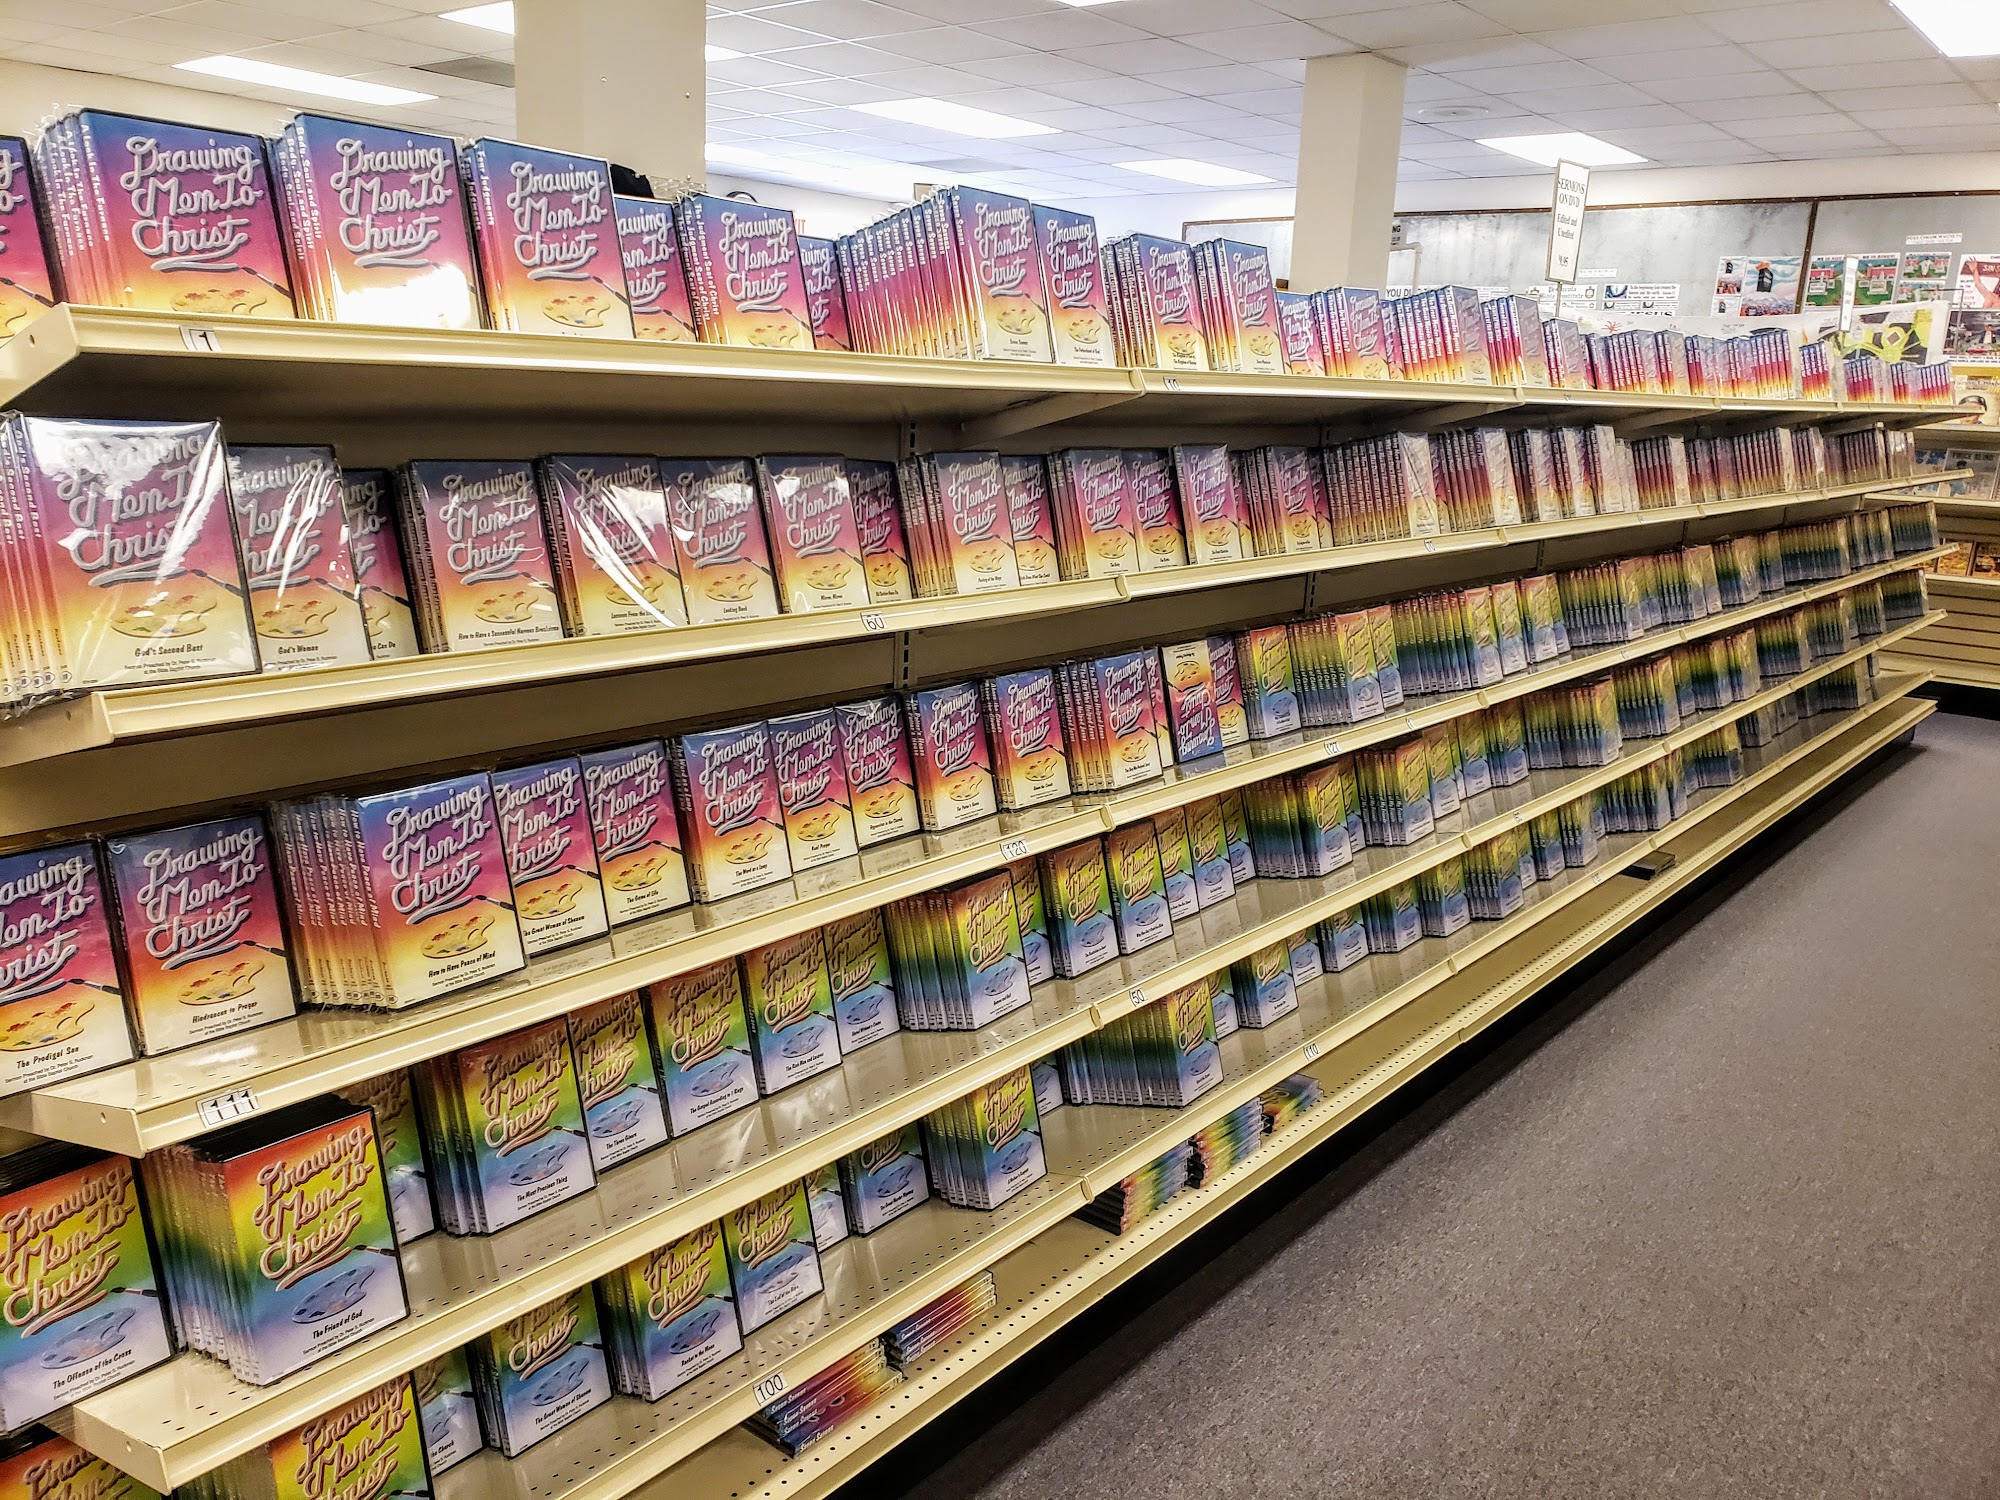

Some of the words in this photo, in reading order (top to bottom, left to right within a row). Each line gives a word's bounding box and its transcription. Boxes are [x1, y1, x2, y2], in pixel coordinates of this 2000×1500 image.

[120, 137, 261, 190] Drawing
[131, 175, 220, 216] Men
[212, 173, 263, 210] To
[1558, 178, 1585, 195] SERMONS
[1559, 193, 1568, 205] ON
[133, 216, 250, 258] Christ
[974, 203, 1029, 239] Drawing
[980, 259, 1026, 287] Christ
[1386, 288, 1401, 298] YOU
[440, 469, 533, 522] Drawing
[948, 458, 999, 497] Drawing
[953, 505, 996, 536] Christ
[448, 531, 526, 573] Christ
[158, 645, 185, 655] Second
[186, 643, 203, 653] Best
[278, 646, 296, 655] God's
[297, 644, 319, 653] Woman
[699, 728, 766, 785] Drawing
[705, 765, 750, 799] Men
[745, 750, 769, 777] To
[383, 785, 488, 860] Drawing
[705, 778, 763, 826] Christ
[137, 828, 263, 903] Drawing
[391, 834, 460, 880] Men
[454, 816, 490, 846] To
[1006, 841, 1027, 857] 120
[147, 880, 224, 924] Men
[220, 858, 264, 890] To
[393, 852, 480, 913] Christ
[626, 896, 634, 904] The
[634, 894, 646, 902] Game
[146, 896, 250, 960] Christ
[531, 926, 545, 934] Great
[545, 922, 562, 931] Woman
[428, 969, 440, 978] How
[446, 964, 460, 974] Have
[460, 960, 476, 968] Peace
[482, 950, 496, 961] Mind
[192, 1009, 228, 1024] Hindrances
[237, 1001, 258, 1012] Prayer
[17, 1060, 30, 1069] The
[32, 1049, 63, 1065] Prodigal
[66, 1046, 79, 1055] Son
[480, 1030, 566, 1102] Drawing
[210, 1090, 256, 1120] 111
[484, 1080, 541, 1121] Men
[485, 1089, 559, 1147] Christ
[253, 1125, 373, 1225] Drawing
[516, 1194, 525, 1202] The
[525, 1189, 537, 1199] Most
[537, 1182, 556, 1194] Precious
[555, 1175, 568, 1187] Thing
[0, 1167, 132, 1268] Drawing
[260, 1192, 335, 1243] Men
[332, 1160, 374, 1198] To
[7, 1224, 91, 1290] Men
[86, 1198, 134, 1236] To
[260, 1199, 361, 1279] Christ
[3, 1240, 120, 1327] Christ
[312, 1329, 323, 1340] The
[324, 1318, 344, 1334] Friend
[344, 1314, 351, 1324] of
[350, 1309, 363, 1321] God
[53, 1380, 65, 1390] The
[66, 1367, 93, 1383] Offense
[94, 1361, 102, 1371] of
[102, 1357, 112, 1367] the
[113, 1349, 132, 1362] Cross
[757, 1374, 784, 1401] 100
[535, 1416, 544, 1425] The
